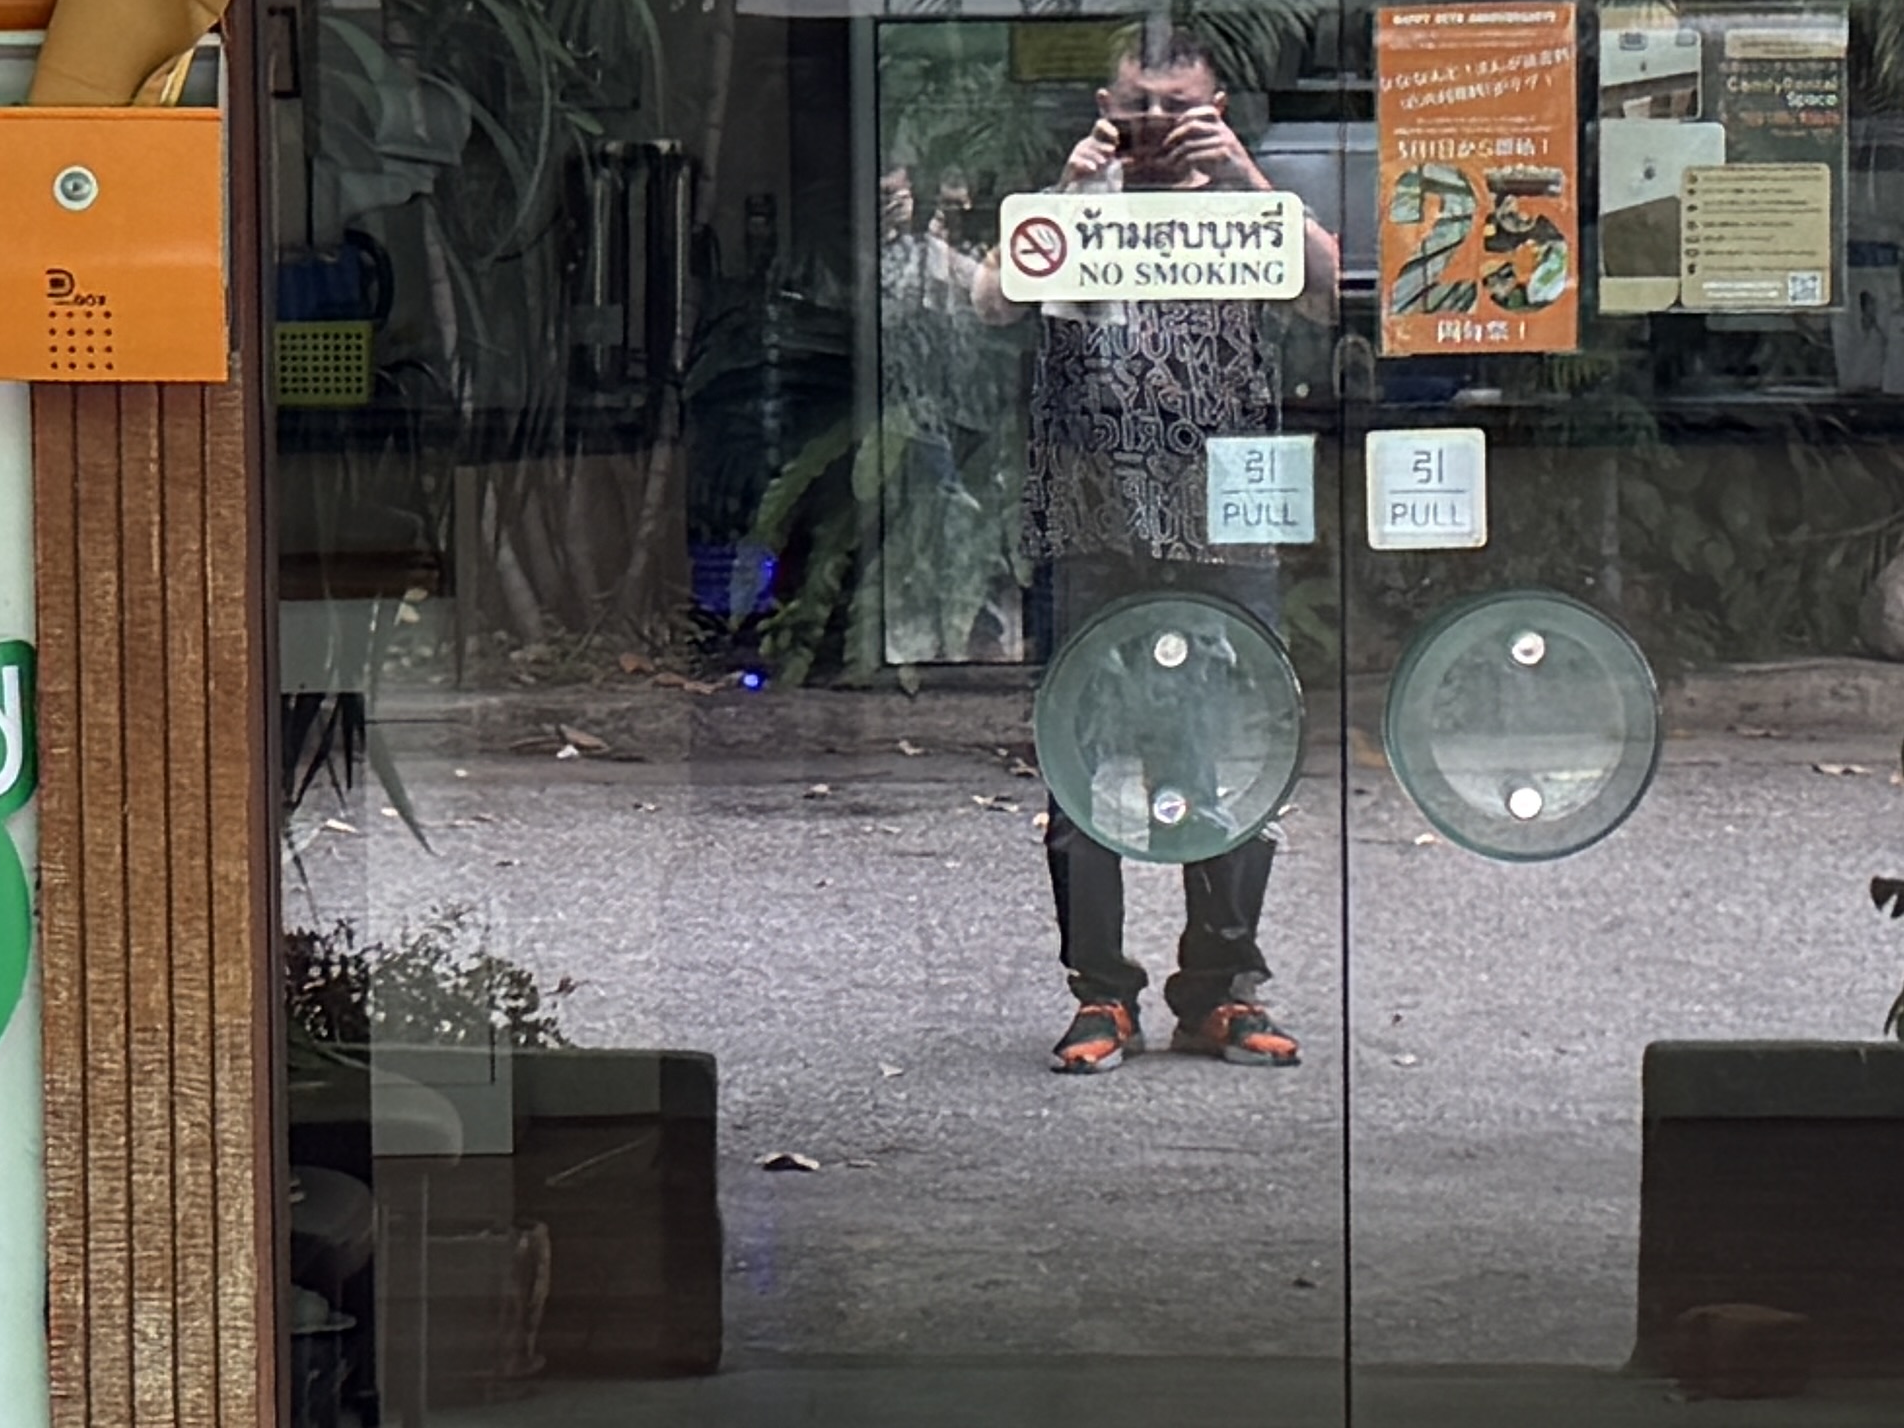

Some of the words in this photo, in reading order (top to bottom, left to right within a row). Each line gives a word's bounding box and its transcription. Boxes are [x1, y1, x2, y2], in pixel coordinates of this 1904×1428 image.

[1079, 262, 1124, 287] NO
[1134, 259, 1285, 286] SMOKING
[1222, 502, 1298, 527] PULL
[1390, 502, 1466, 527] PULL
